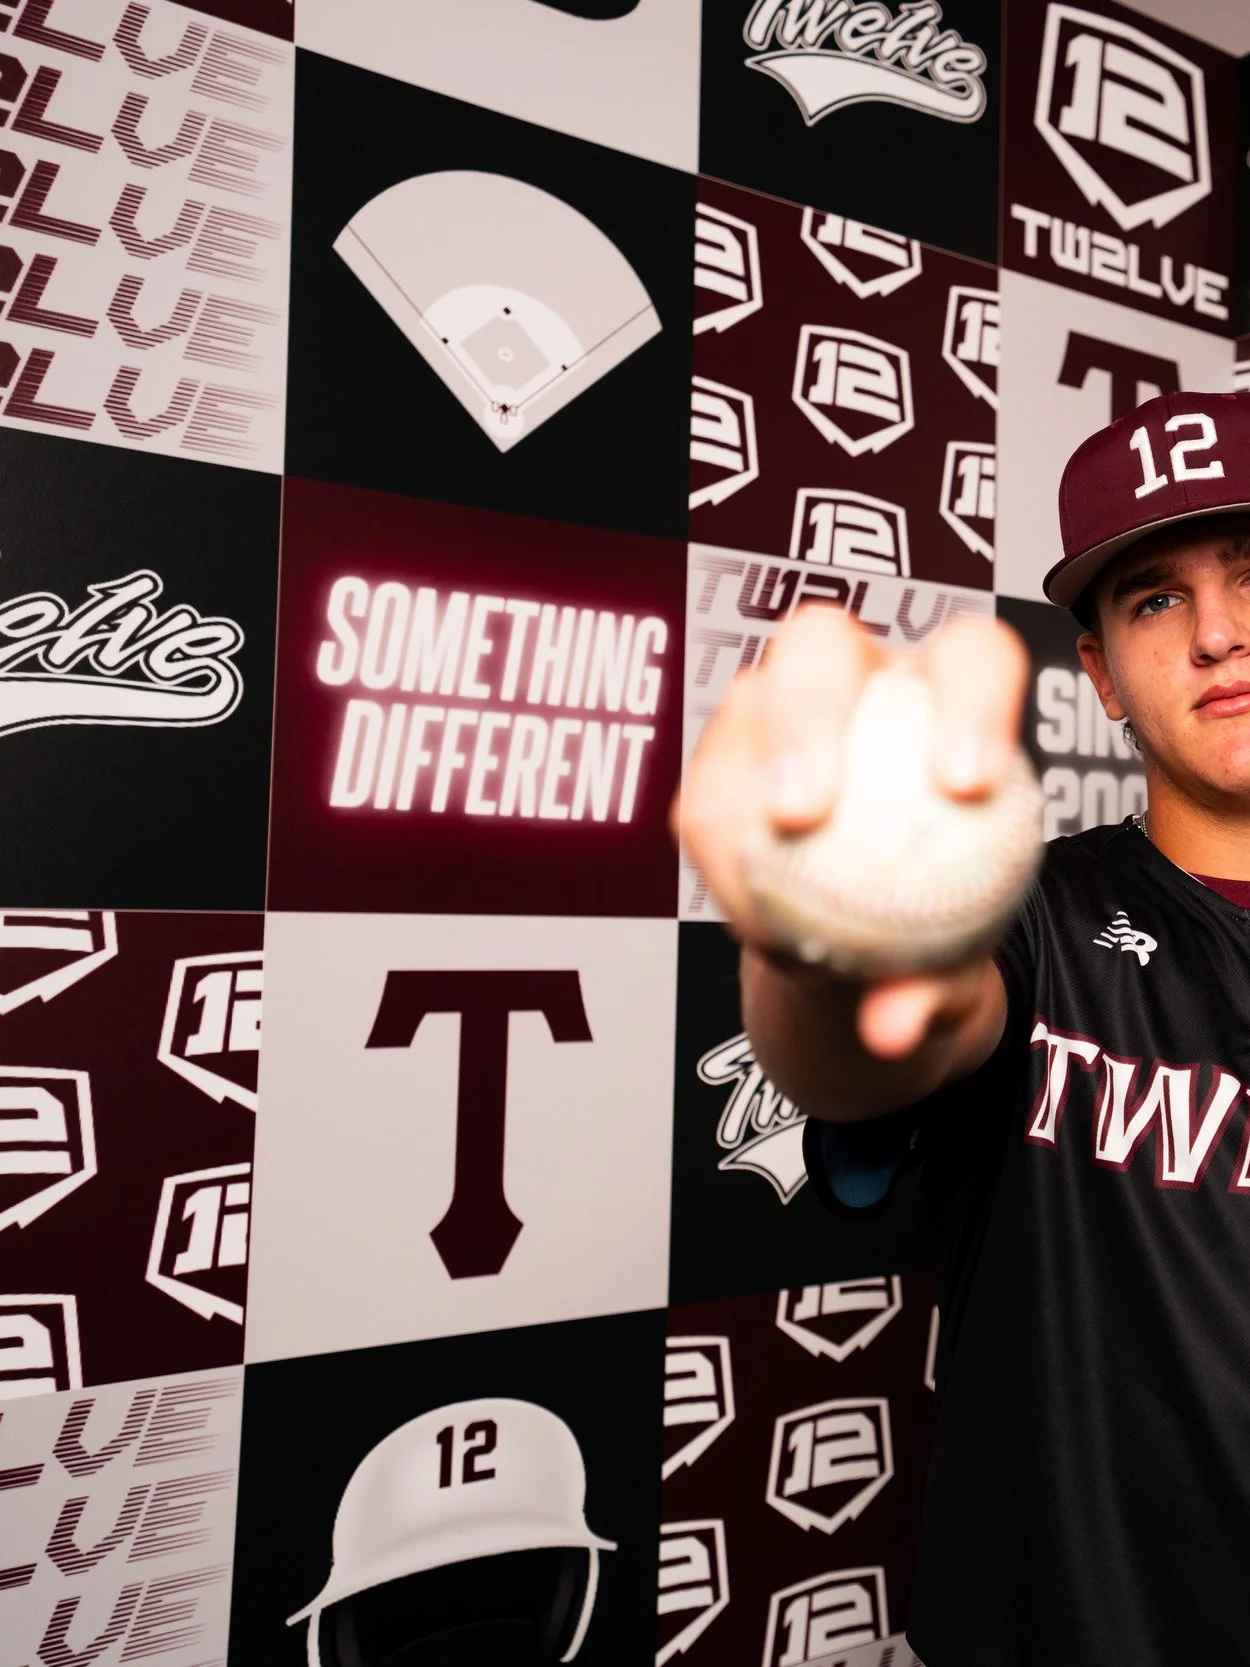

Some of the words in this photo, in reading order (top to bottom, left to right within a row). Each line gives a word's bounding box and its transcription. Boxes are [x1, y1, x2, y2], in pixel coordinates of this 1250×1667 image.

[1058, 33, 1195, 183] 12
[808, 340, 902, 423] 12
[1129, 413, 1225, 499] 12
[317, 575, 669, 716] SOMETHING
[329, 700, 656, 824] DIFFERENT
[364, 969, 594, 1280] T
[436, 1419, 499, 1489] 12
[783, 1412, 881, 1498] 12
